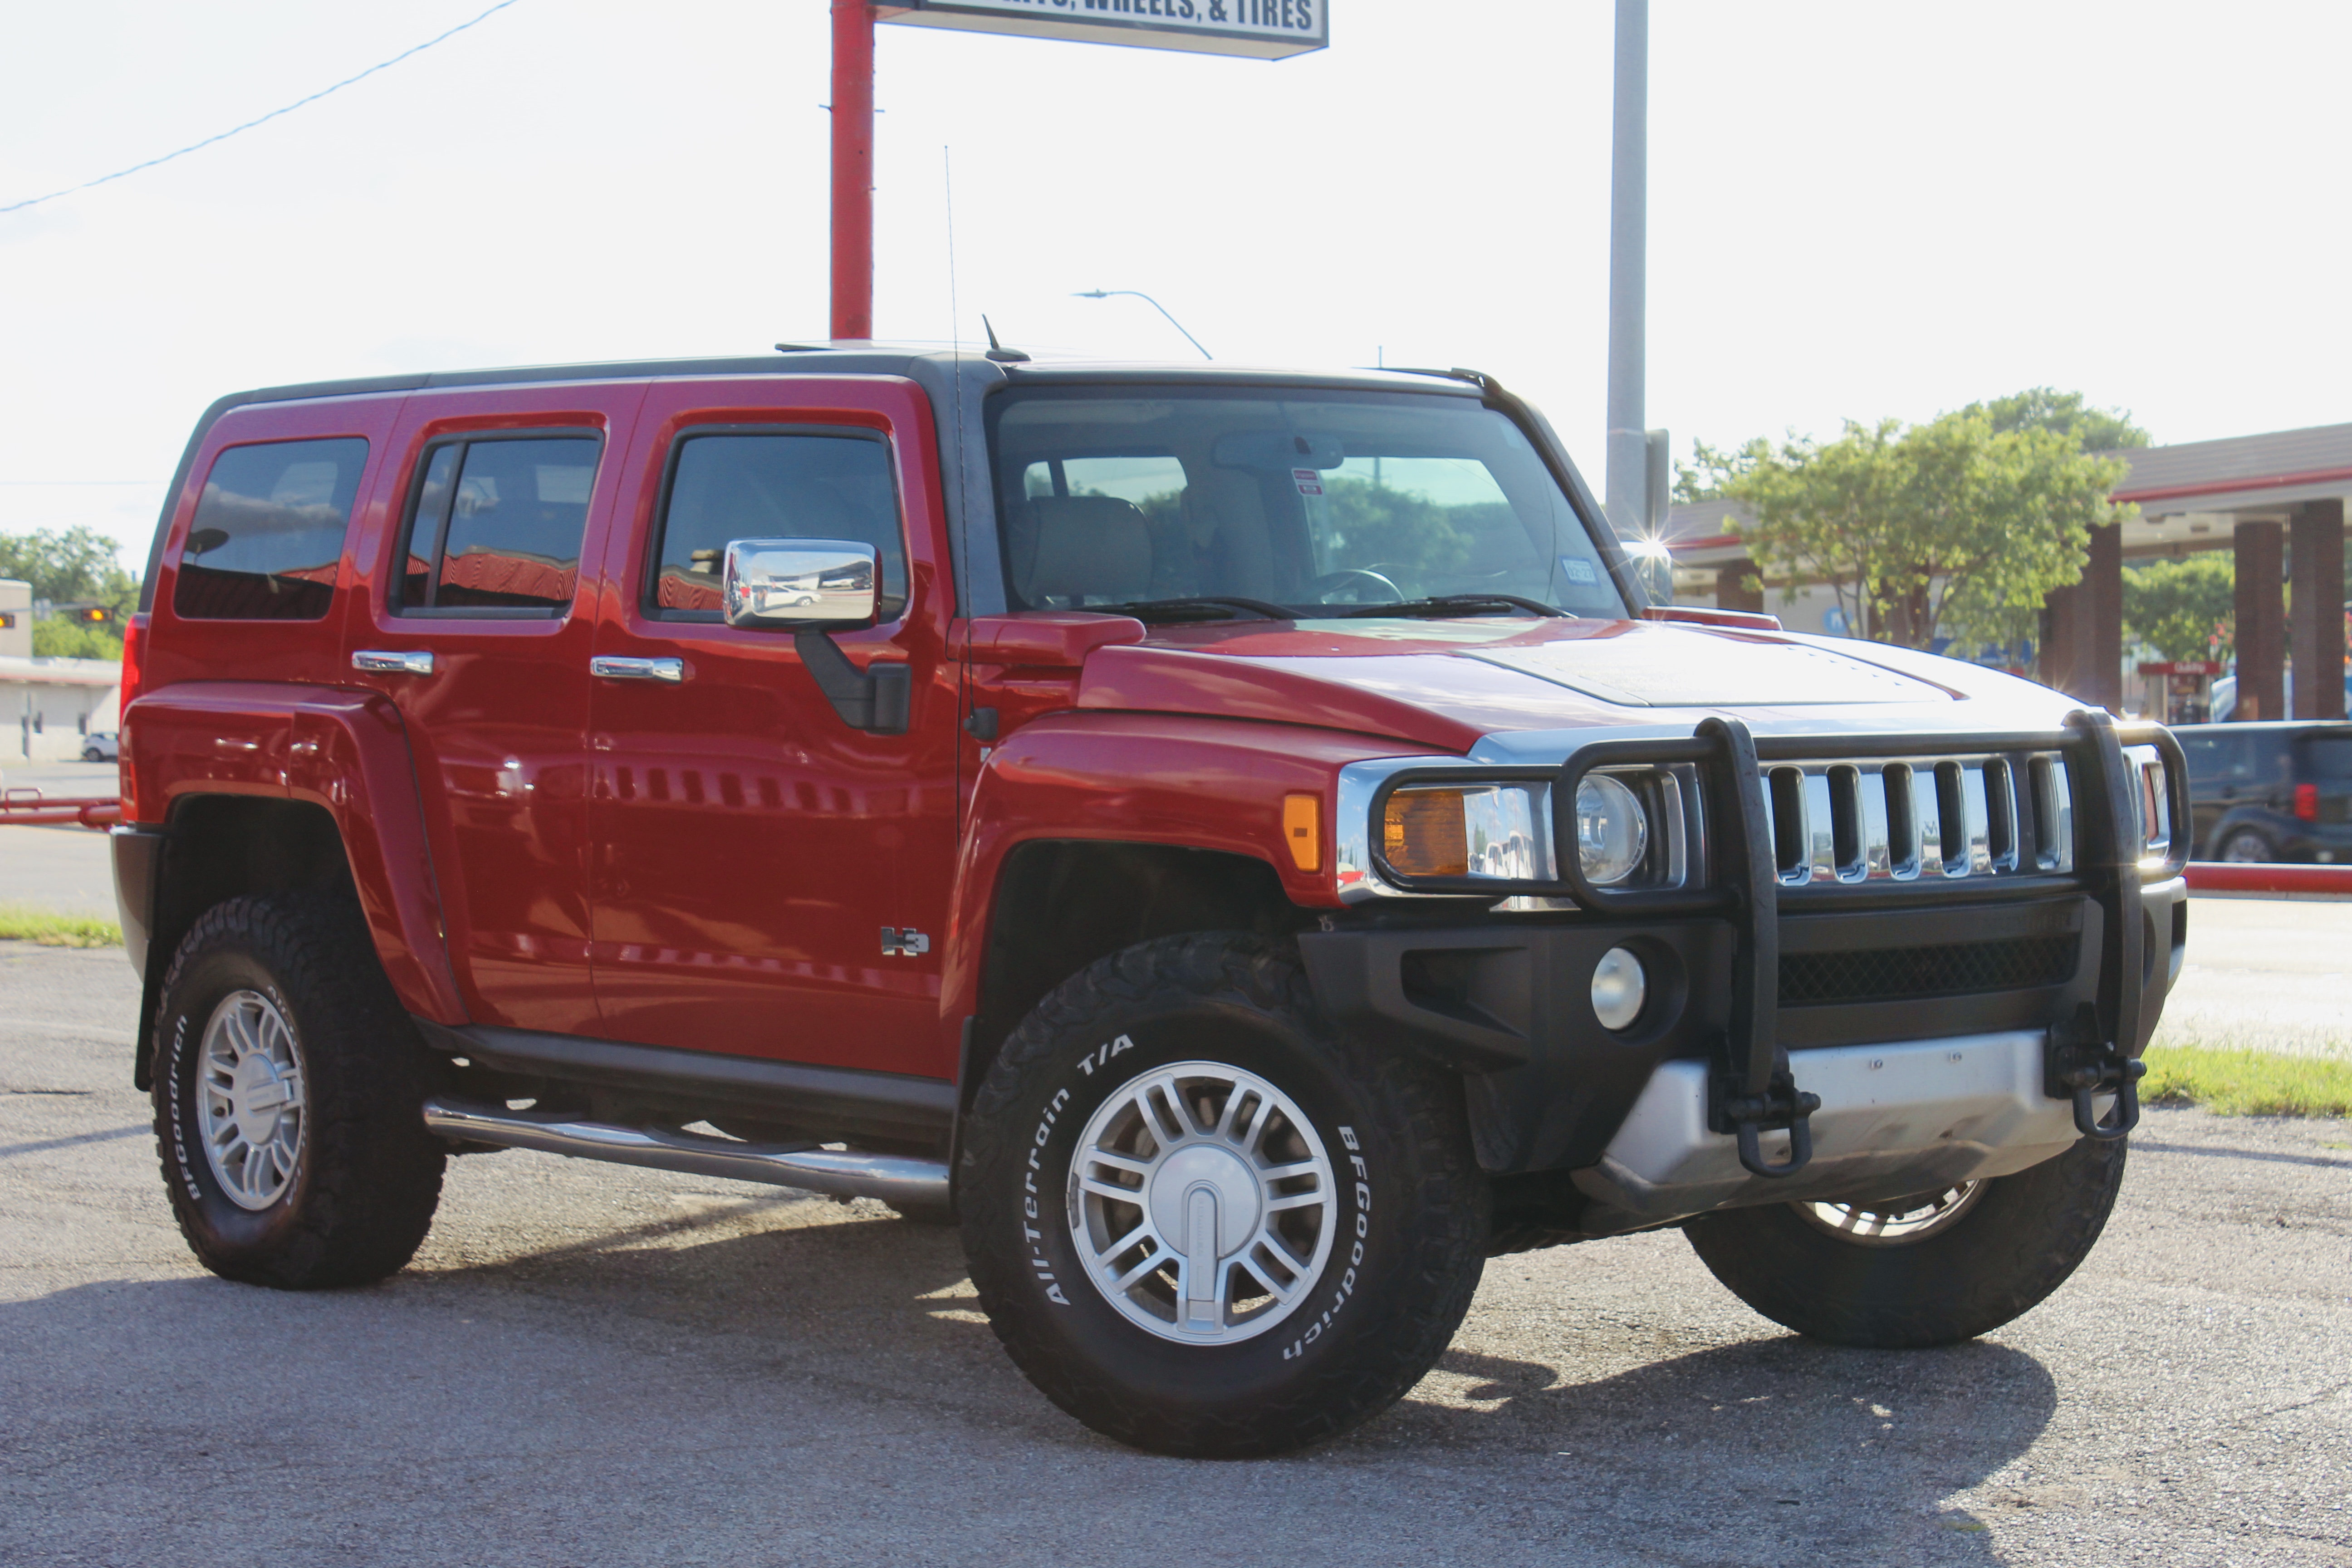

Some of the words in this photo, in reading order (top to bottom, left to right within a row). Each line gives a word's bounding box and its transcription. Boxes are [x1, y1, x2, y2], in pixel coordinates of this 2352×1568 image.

[1085, 0, 1202, 23] EELS,
[1210, 0, 1228, 21] &
[1238, 0, 1312, 30] TIRES
[881, 926, 929, 956] H3
[169, 1015, 201, 1200] BFGoodrich
[1023, 1088, 1069, 1306] All-Terrain
[1077, 1034, 1134, 1076] T/A
[1283, 1126, 1370, 1360] BFGoodrich
